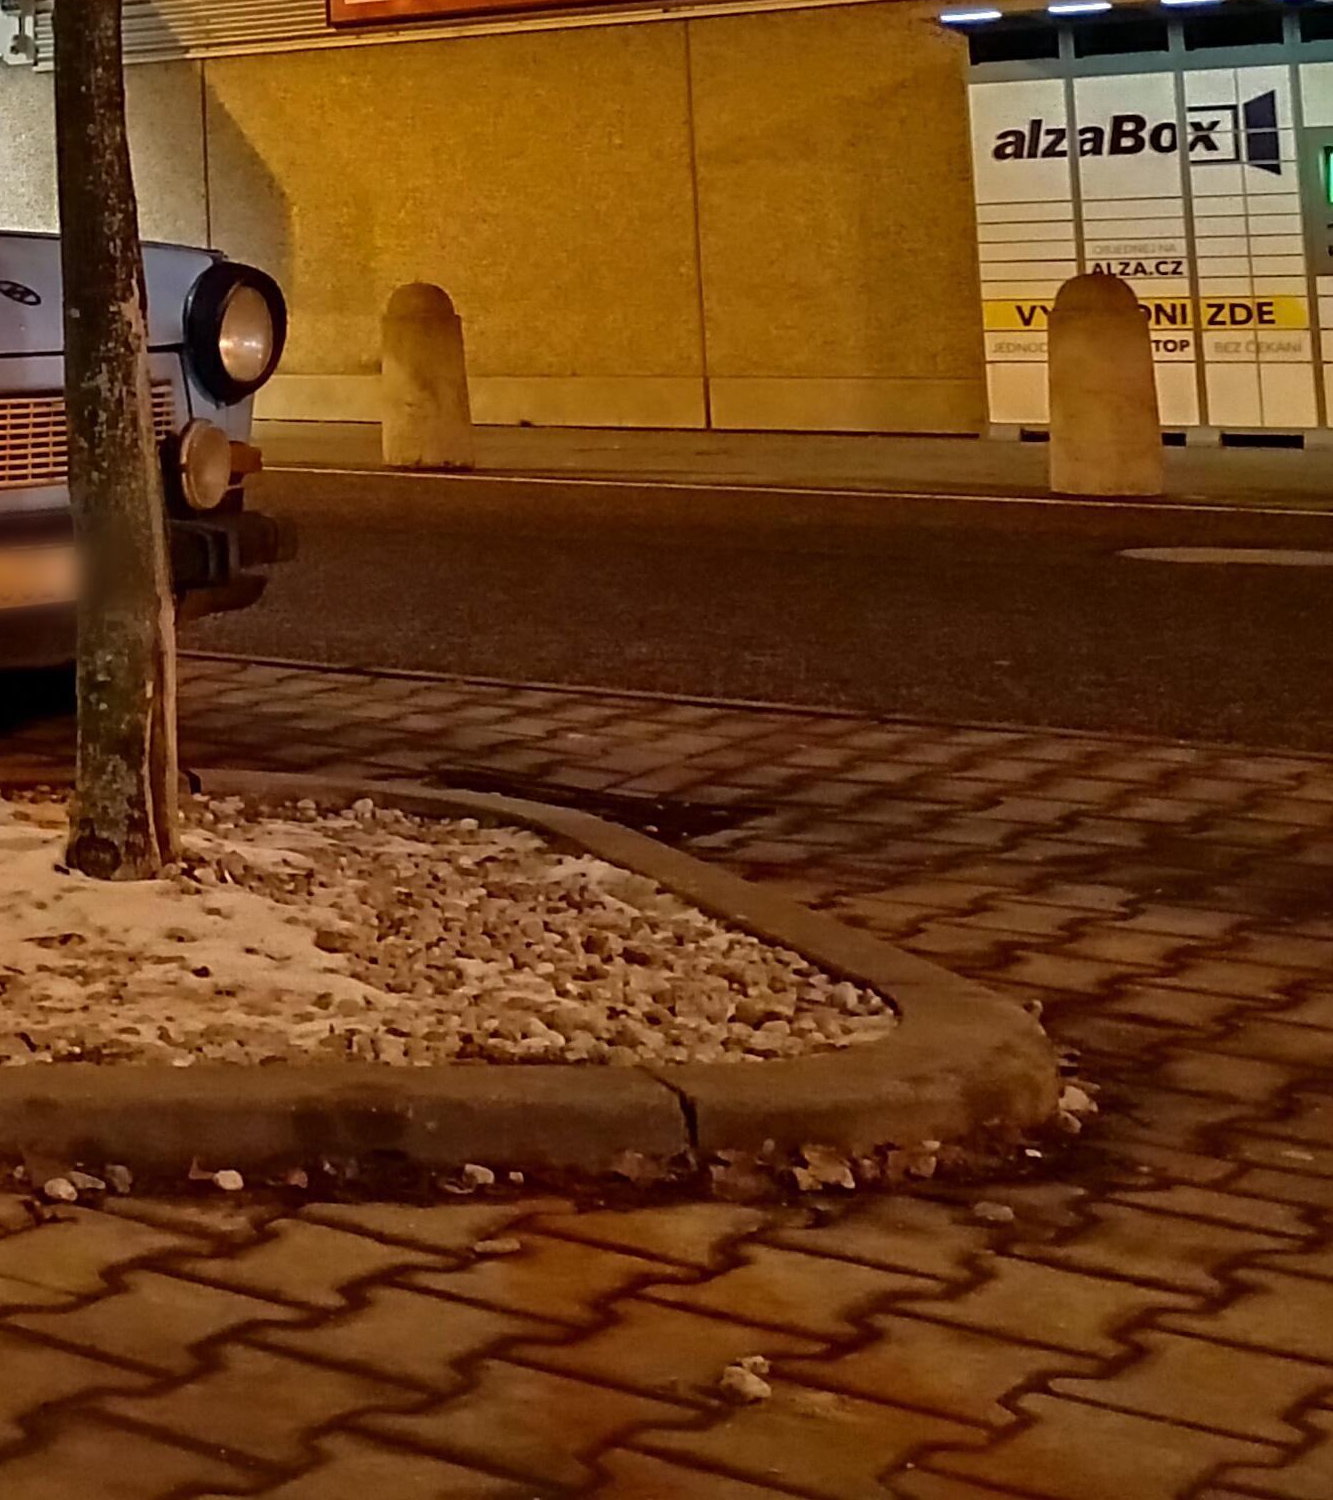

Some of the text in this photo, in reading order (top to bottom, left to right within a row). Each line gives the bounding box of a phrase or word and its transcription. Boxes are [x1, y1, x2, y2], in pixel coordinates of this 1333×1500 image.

[992, 113, 1221, 160] alzaBox
[1091, 260, 1183, 276] ALZA.CZ
[1206, 302, 1276, 326] ZDE
